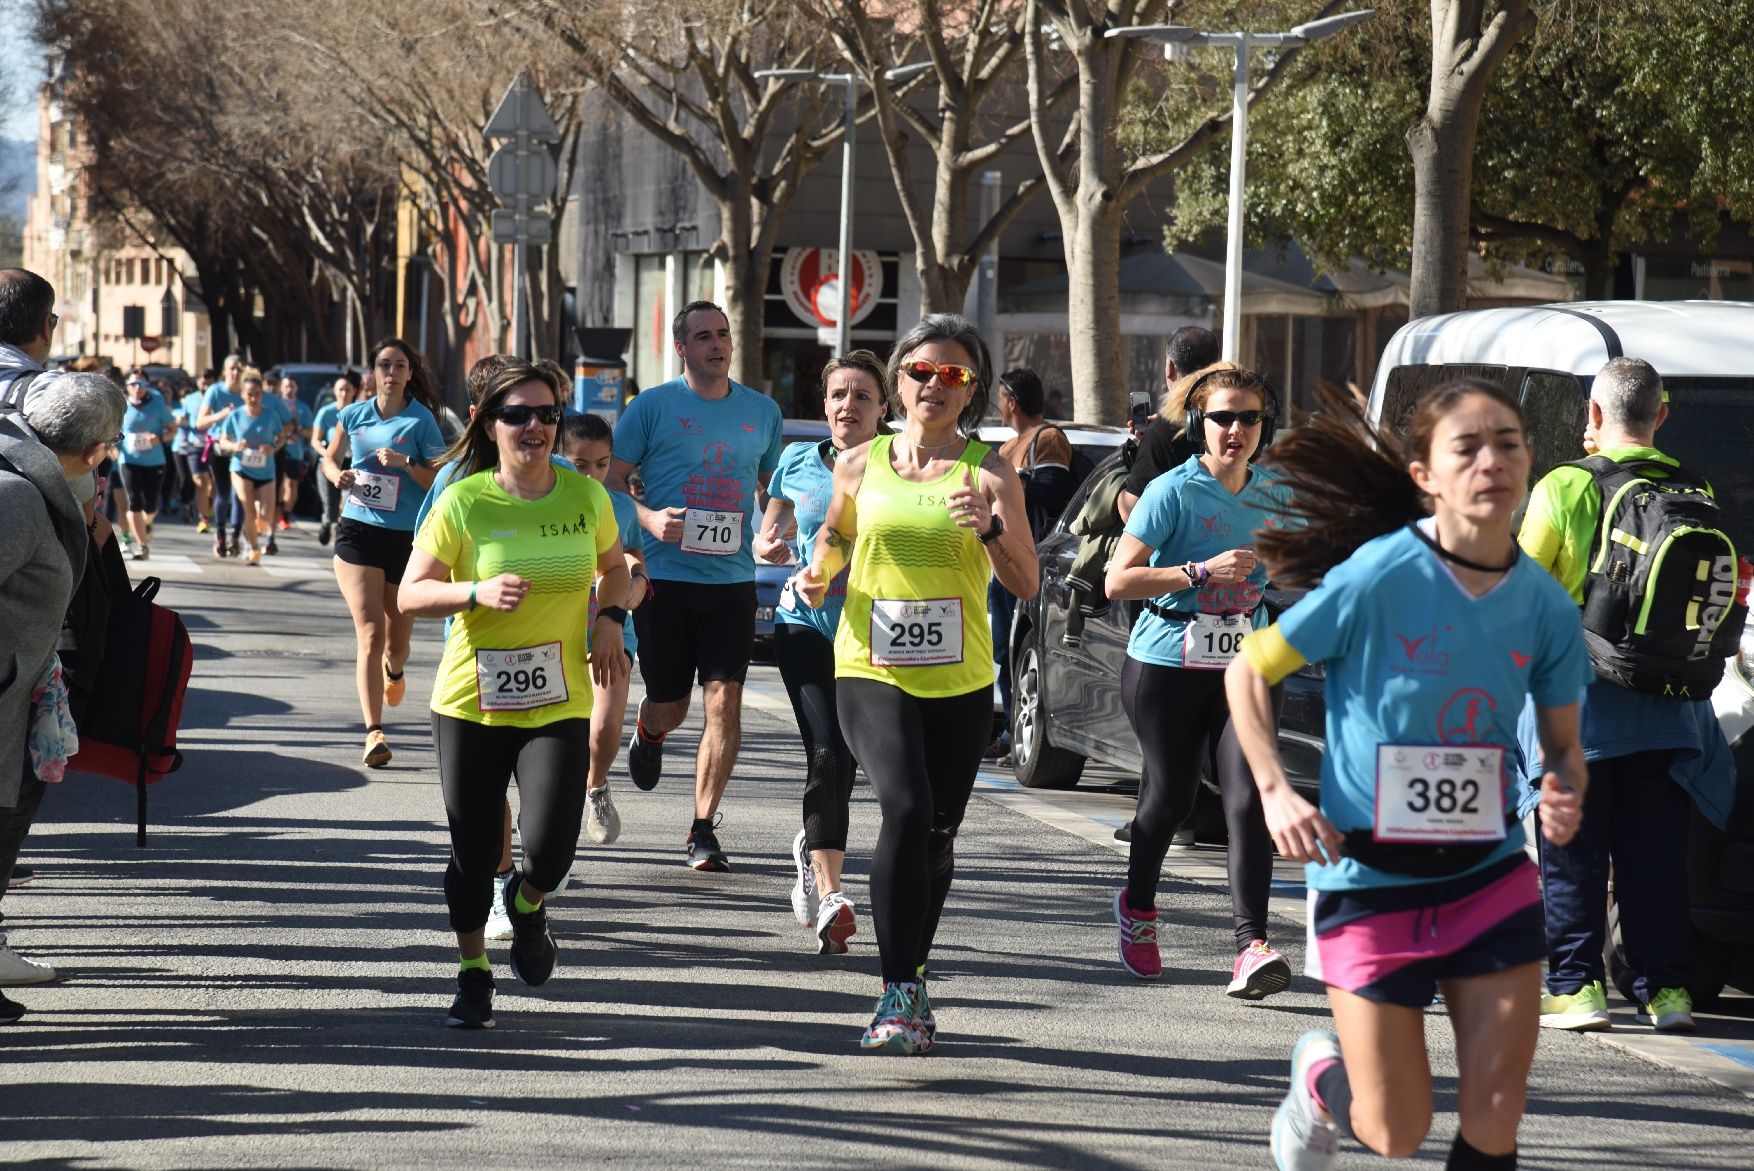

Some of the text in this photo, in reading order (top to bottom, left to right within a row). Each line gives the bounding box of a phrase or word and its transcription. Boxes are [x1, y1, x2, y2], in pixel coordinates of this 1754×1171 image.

[363, 484, 382, 499] 32
[696, 524, 733, 544] 710
[890, 622, 943, 647] 295
[1204, 632, 1245, 653] 108
[497, 667, 547, 693] 296
[1407, 777, 1479, 813] 382
